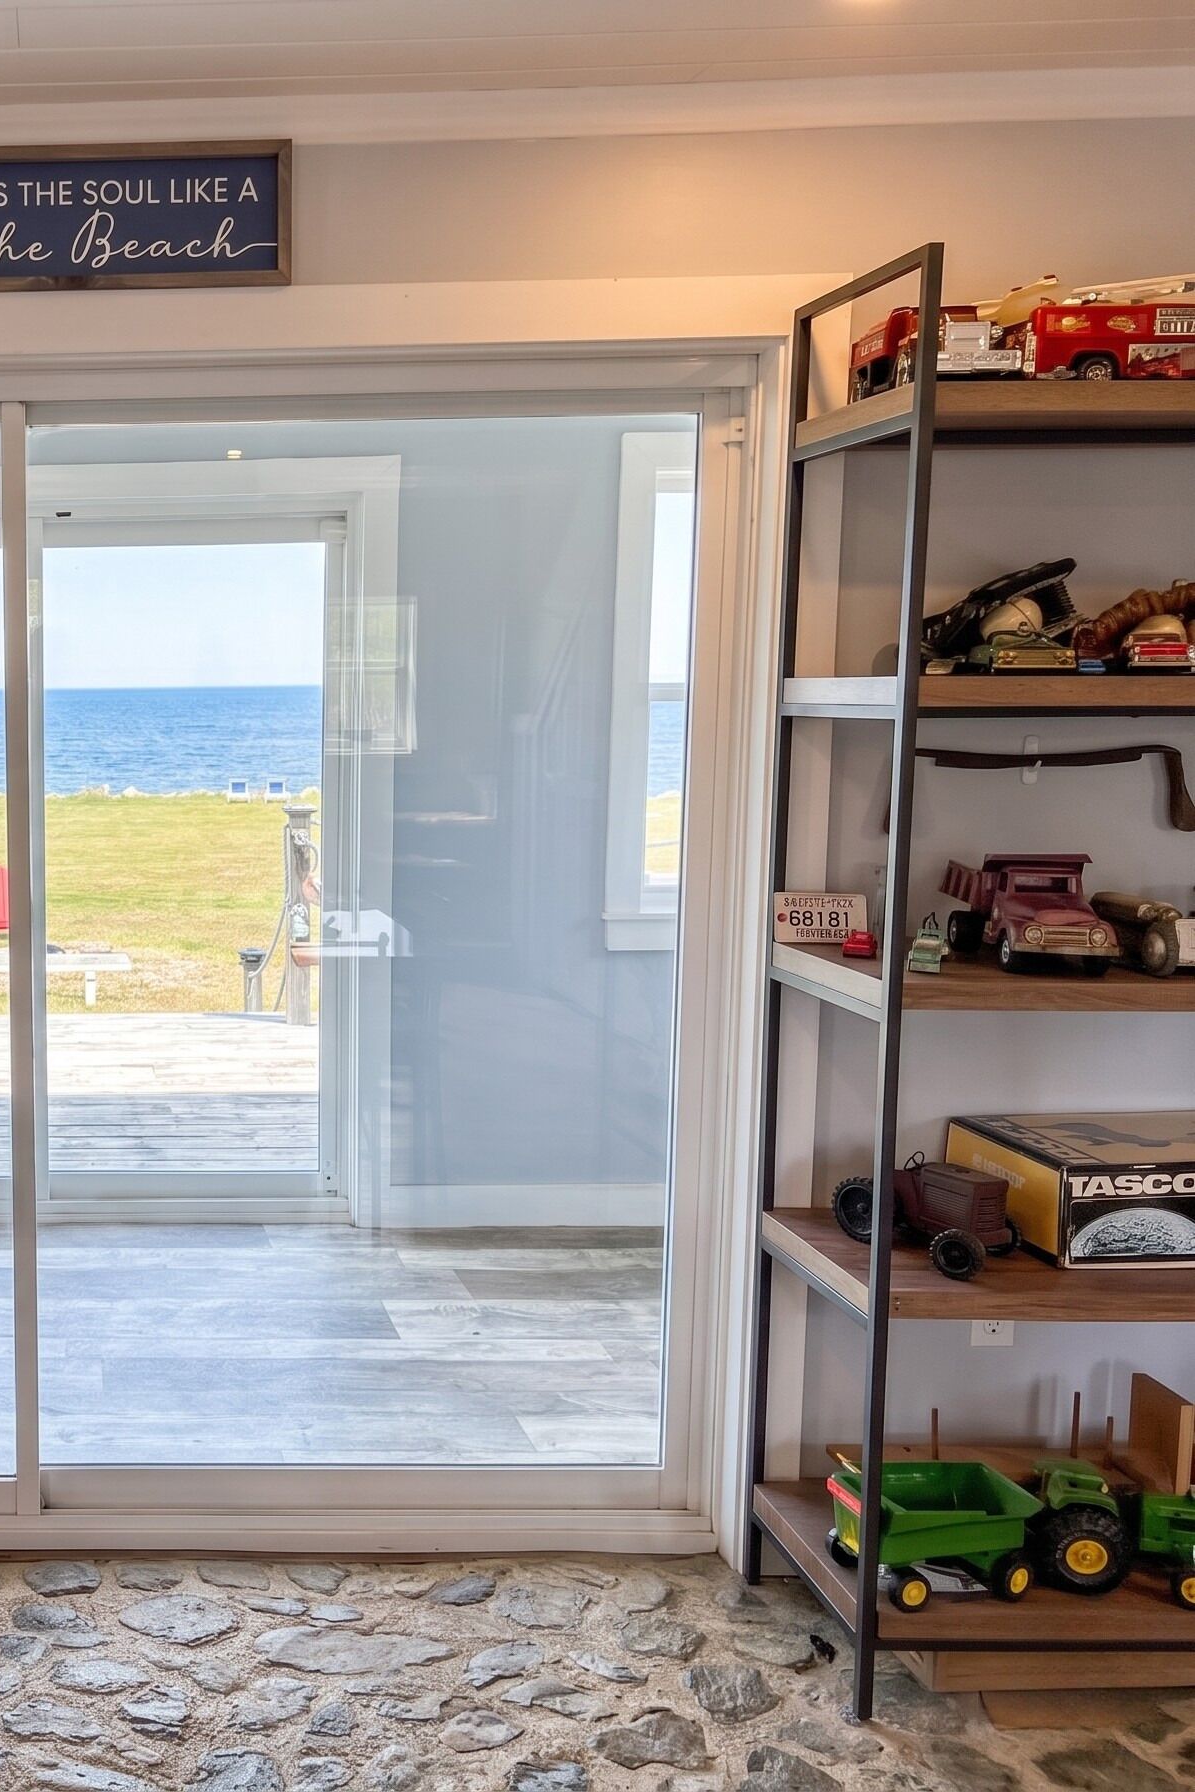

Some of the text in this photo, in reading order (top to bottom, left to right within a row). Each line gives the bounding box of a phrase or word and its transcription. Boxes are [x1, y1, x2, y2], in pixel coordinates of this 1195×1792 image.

[17, 181, 73, 207] THE
[82, 179, 161, 206] SOUL
[170, 177, 228, 204] LIKE
[237, 176, 259, 204] A
[70, 208, 278, 269] Beach
[789, 910, 849, 928] 68181
[1068, 1172, 1195, 1198] TASCO
